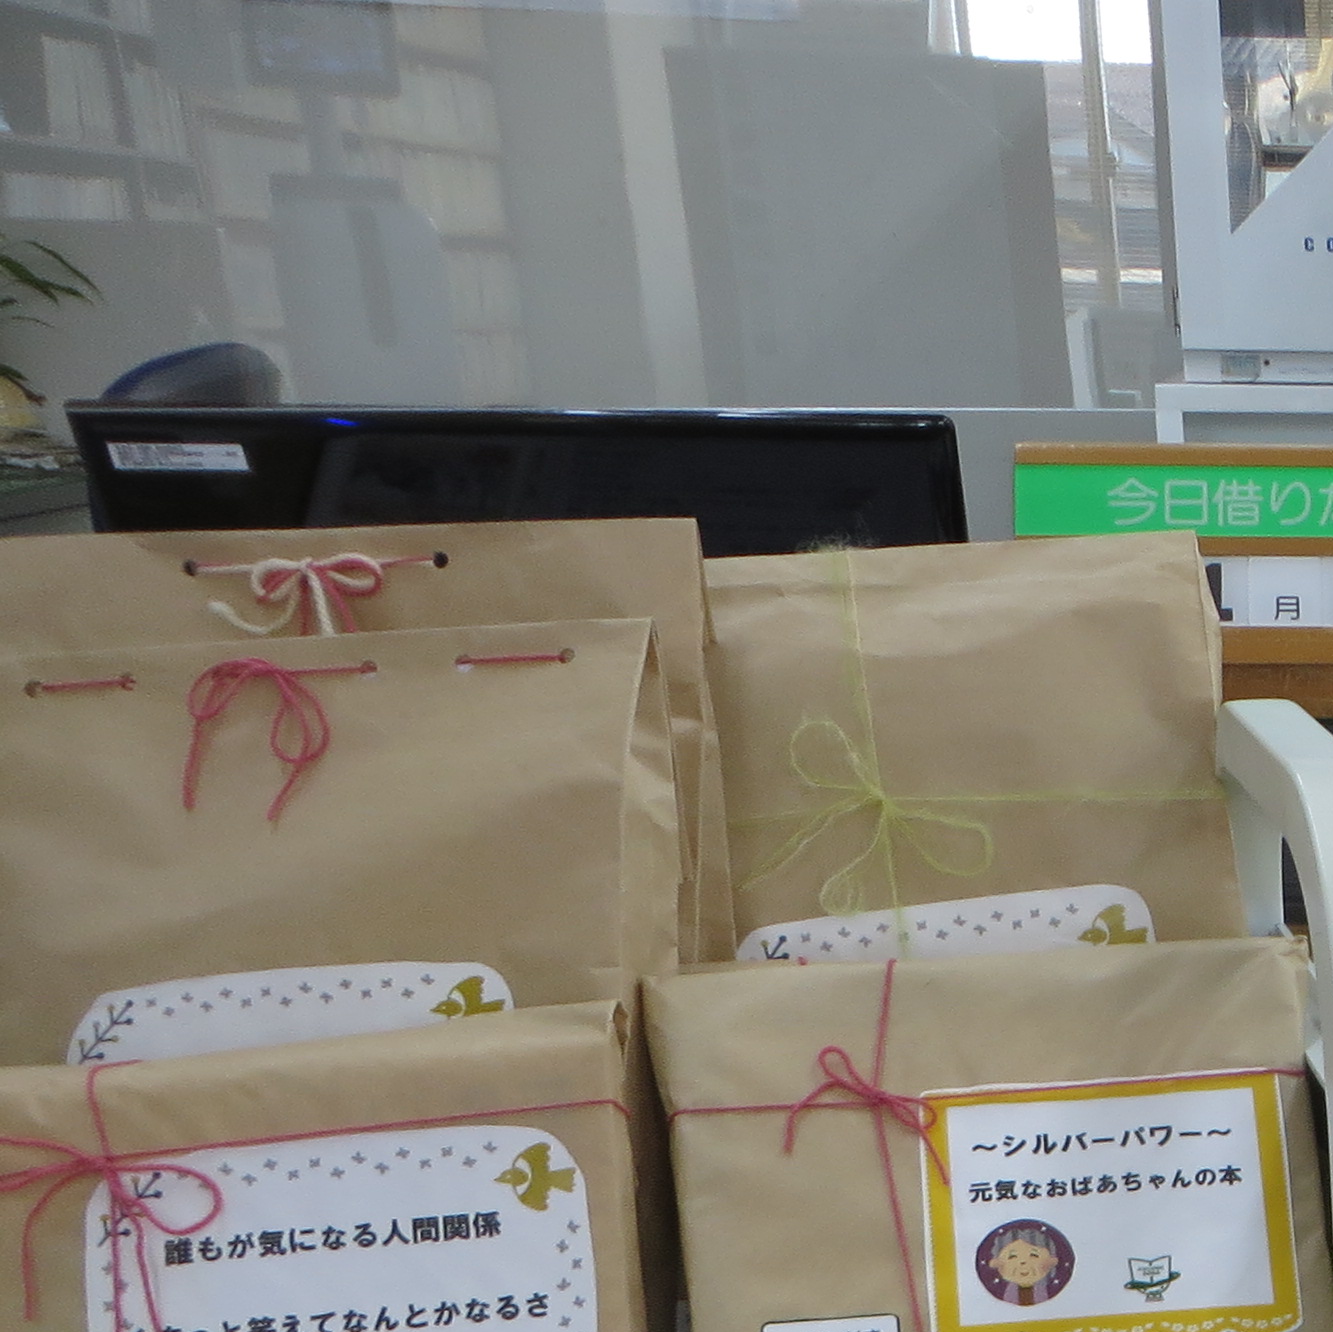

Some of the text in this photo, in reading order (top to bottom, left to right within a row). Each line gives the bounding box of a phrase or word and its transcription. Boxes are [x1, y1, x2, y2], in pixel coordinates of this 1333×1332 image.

[968, 1164, 1242, 1203] 元気なおばあちゃんの本
[164, 1210, 501, 1266] 誰もが気になる人間関係
